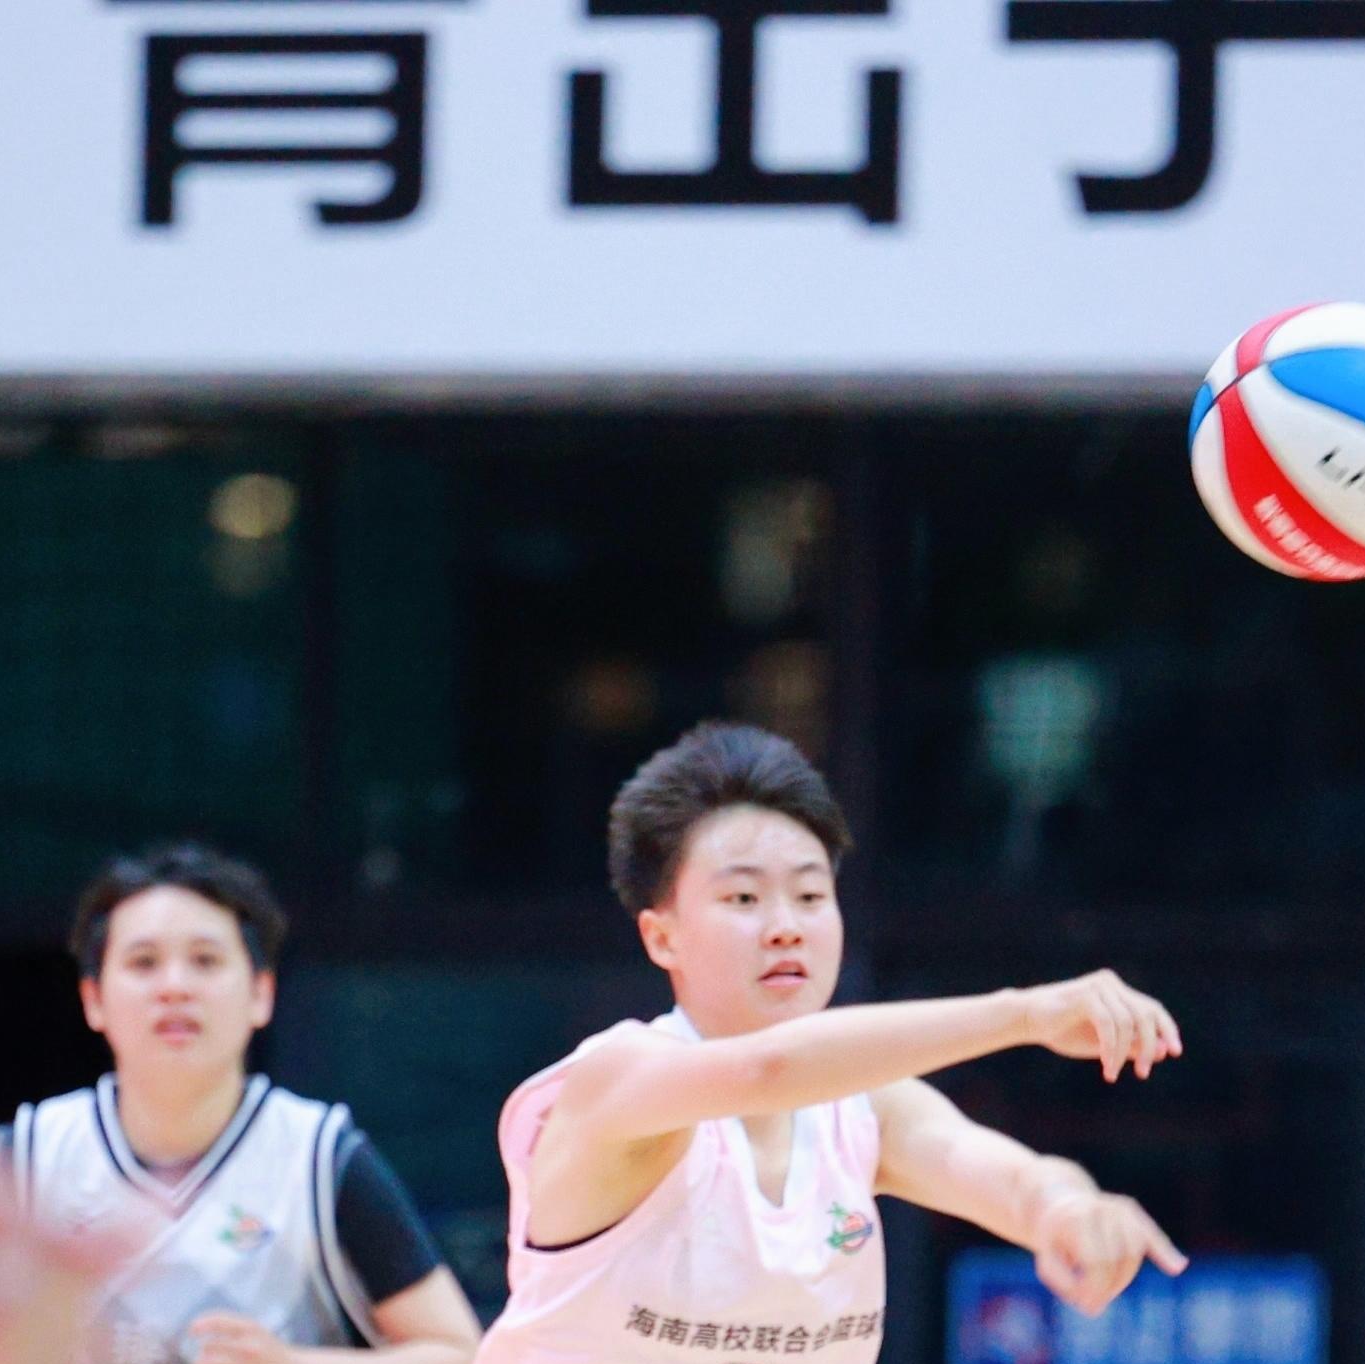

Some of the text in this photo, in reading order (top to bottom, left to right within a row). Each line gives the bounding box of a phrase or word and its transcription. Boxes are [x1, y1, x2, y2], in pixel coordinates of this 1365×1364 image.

[624, 1303, 886, 1354] 海南高校联合会篮球
